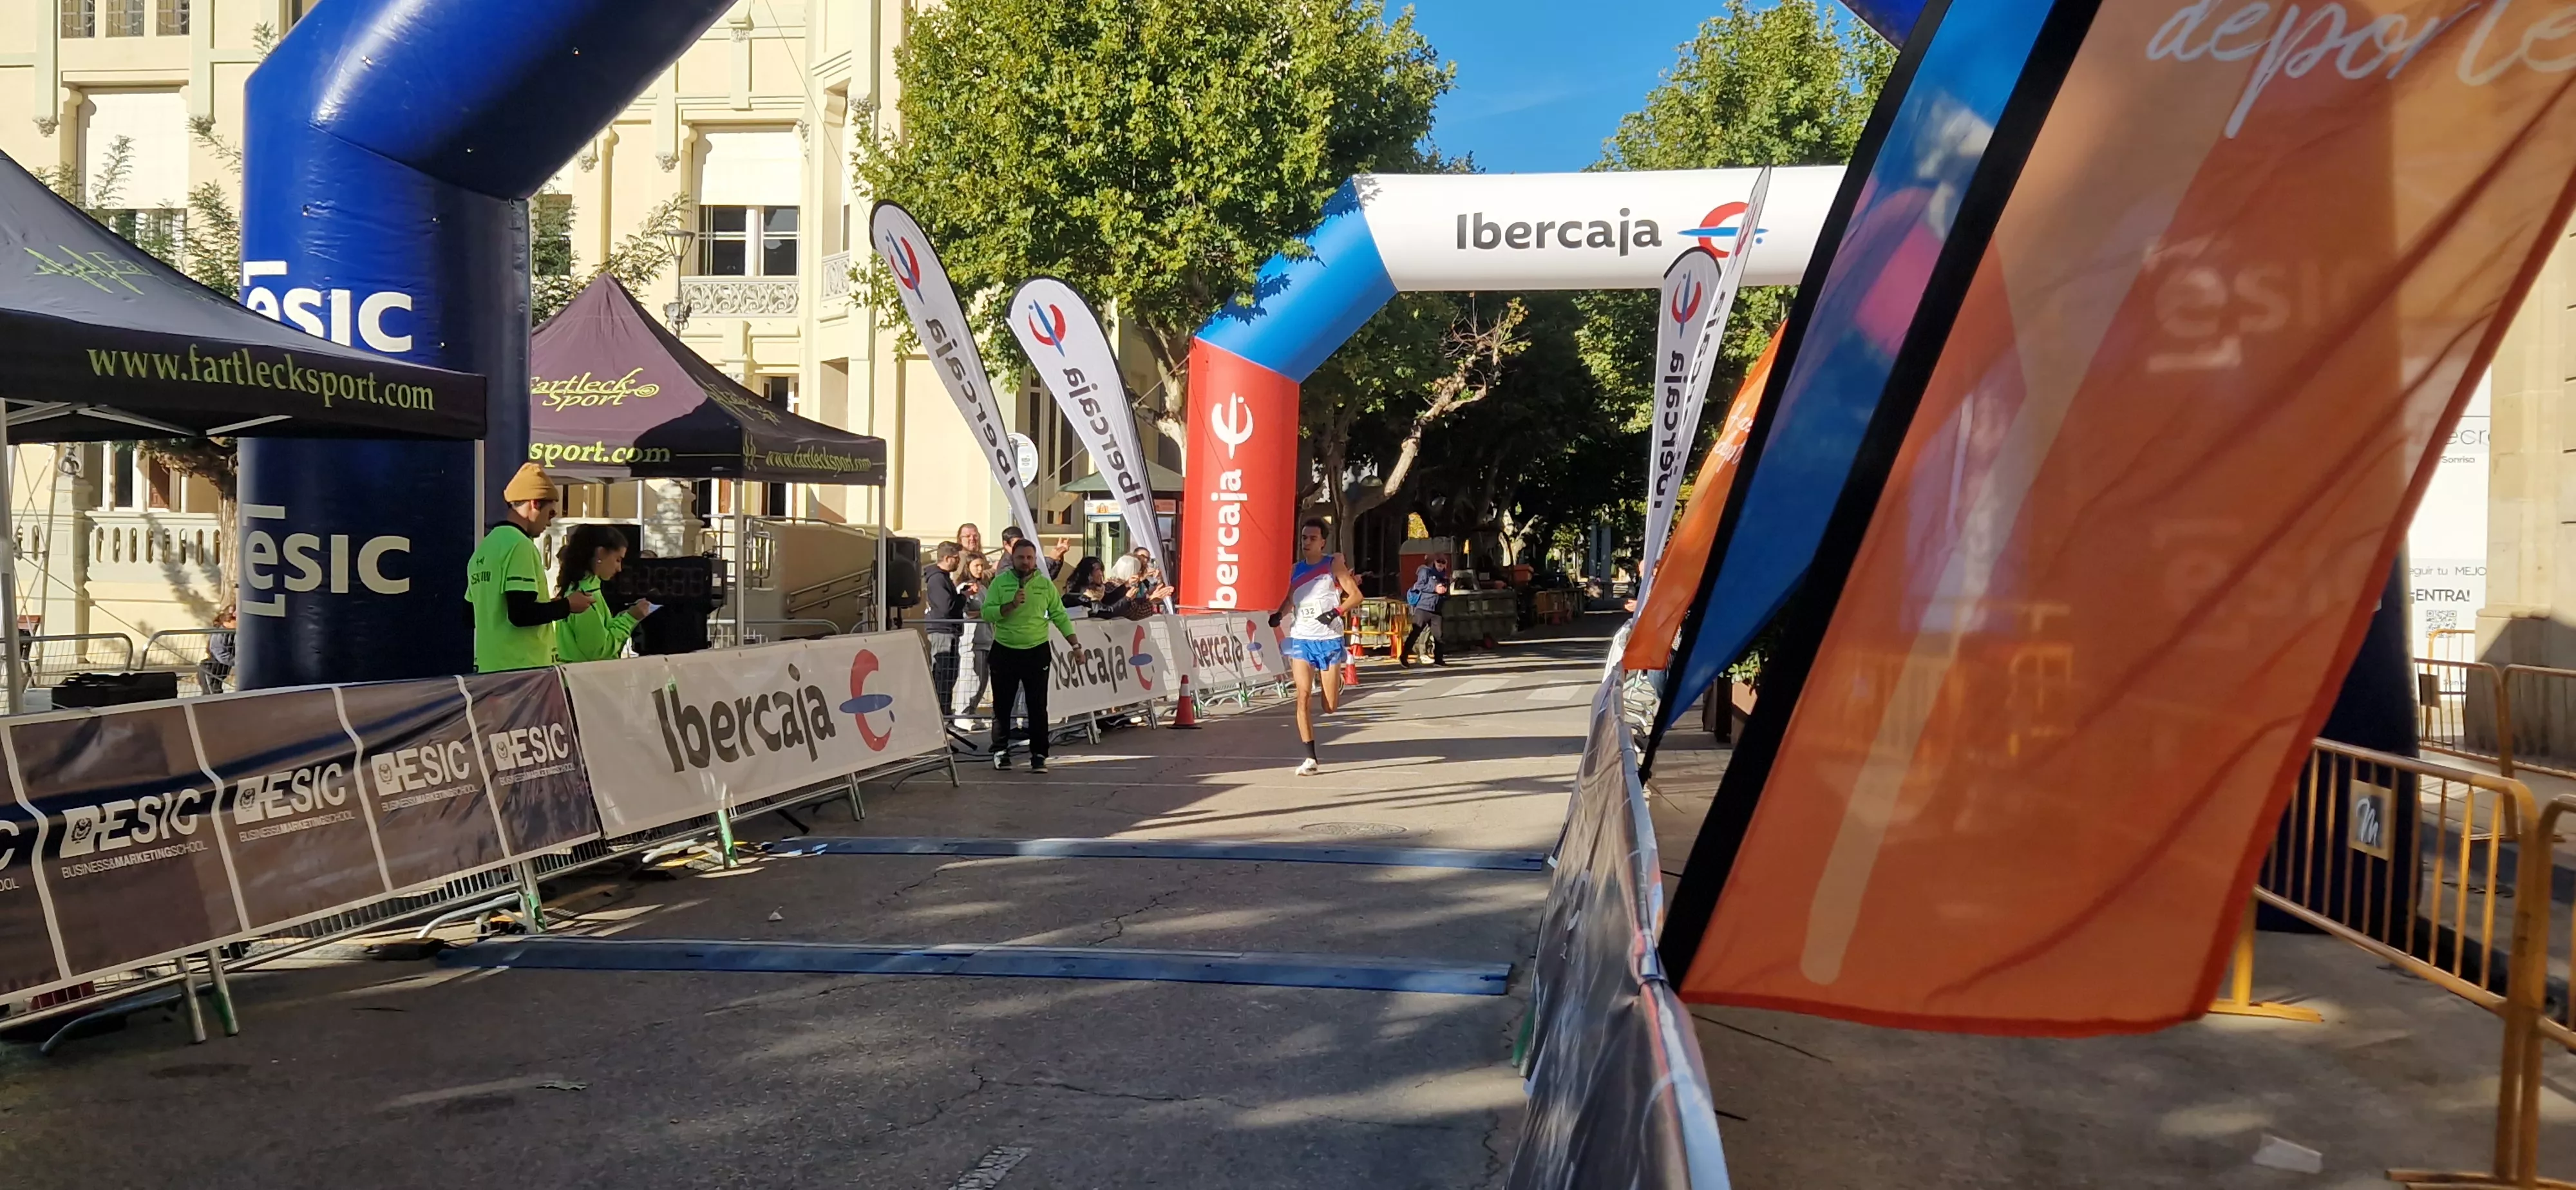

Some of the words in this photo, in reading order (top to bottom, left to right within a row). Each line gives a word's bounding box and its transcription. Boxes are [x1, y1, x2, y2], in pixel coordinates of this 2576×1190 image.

[1456, 207, 1662, 257] Ibercaja
[87, 344, 435, 411] www.fartlecksport.com
[542, 388, 629, 412] Sport
[530, 440, 670, 468] sport.com
[1208, 469, 1247, 609] bercaja
[2409, 567, 2433, 577] eguir
[2437, 567, 2448, 576] tu
[2455, 567, 2486, 576] MEJO
[1301, 607, 1315, 616] 132
[651, 663, 837, 773] Ibercaja
[397, 741, 471, 791] ESIC
[509, 723, 569, 767] ESIC
[263, 762, 346, 818] ESIC
[98, 789, 201, 851] ESIC
[62, 840, 209, 879] BUSINESS&MARKETINGSCHOOL
